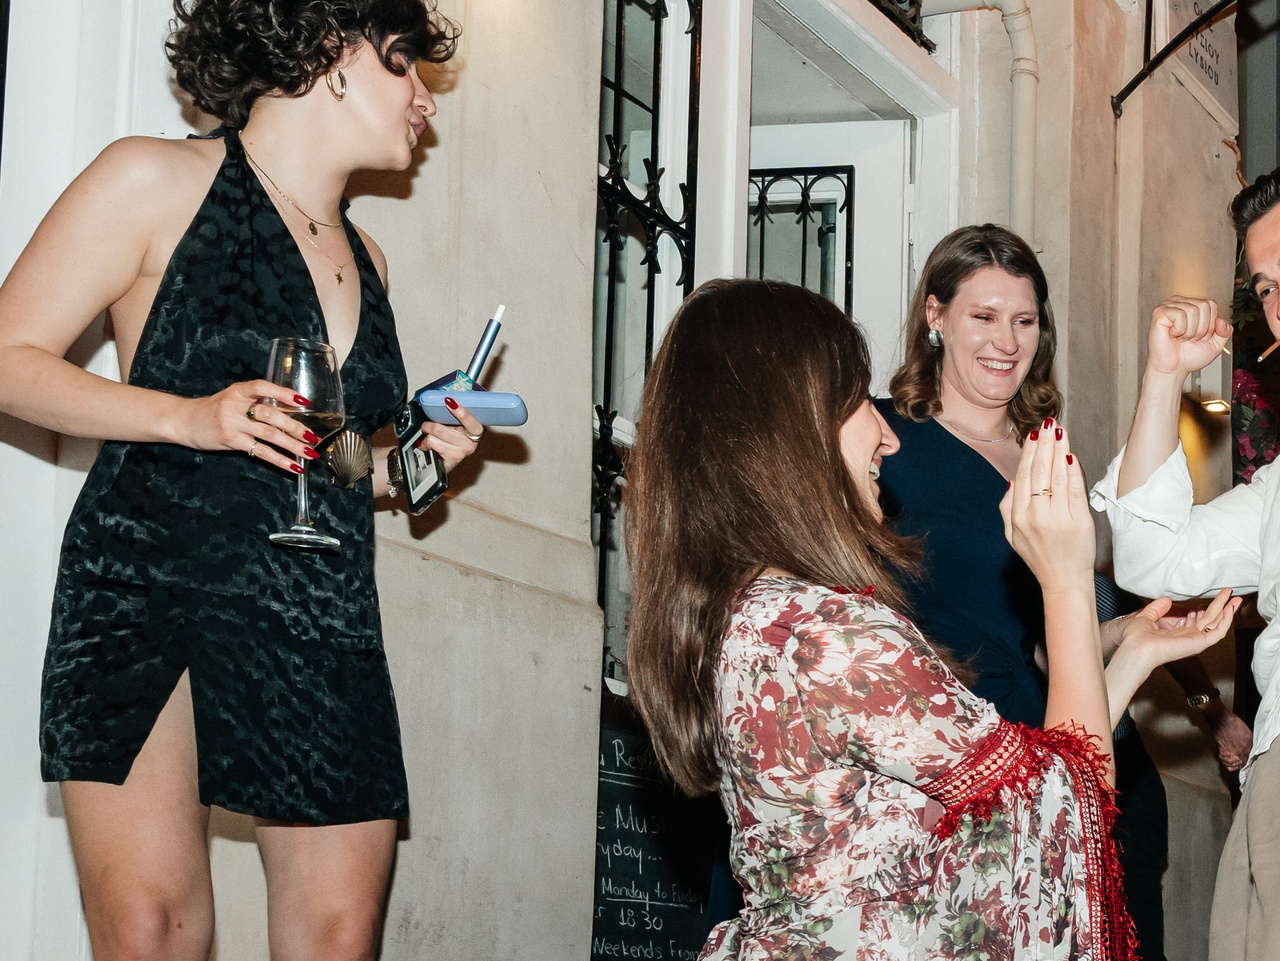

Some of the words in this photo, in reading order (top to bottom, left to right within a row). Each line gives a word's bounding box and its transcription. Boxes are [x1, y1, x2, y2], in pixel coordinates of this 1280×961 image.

[1188, 42, 1219, 86] LYSIOU
[602, 876, 650, 912] Monday
[654, 880, 668, 899] to
[592, 937, 663, 960] Weekends
